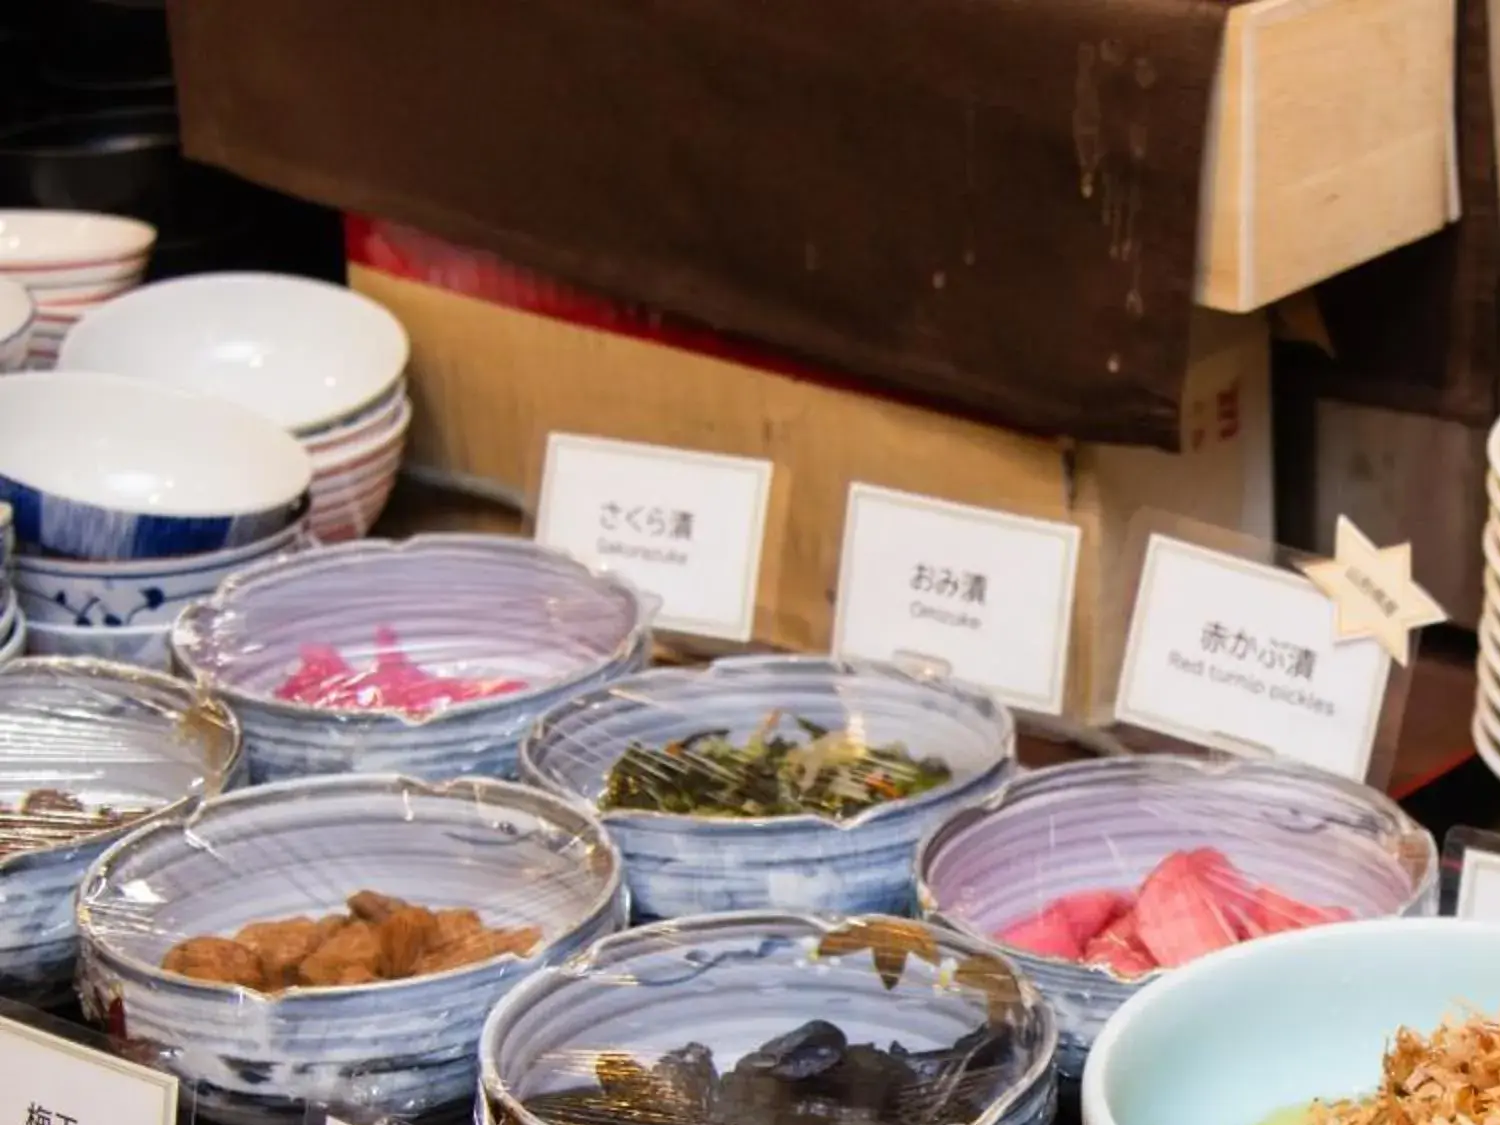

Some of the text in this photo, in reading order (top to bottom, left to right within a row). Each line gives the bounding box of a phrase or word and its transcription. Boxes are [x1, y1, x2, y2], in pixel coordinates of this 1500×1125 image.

[600, 502, 694, 541] さくら漬
[909, 562, 988, 606] おみ漬
[1201, 620, 1317, 682] 赤かぶ漬
[1167, 649, 1335, 717] Red turnip pickles
